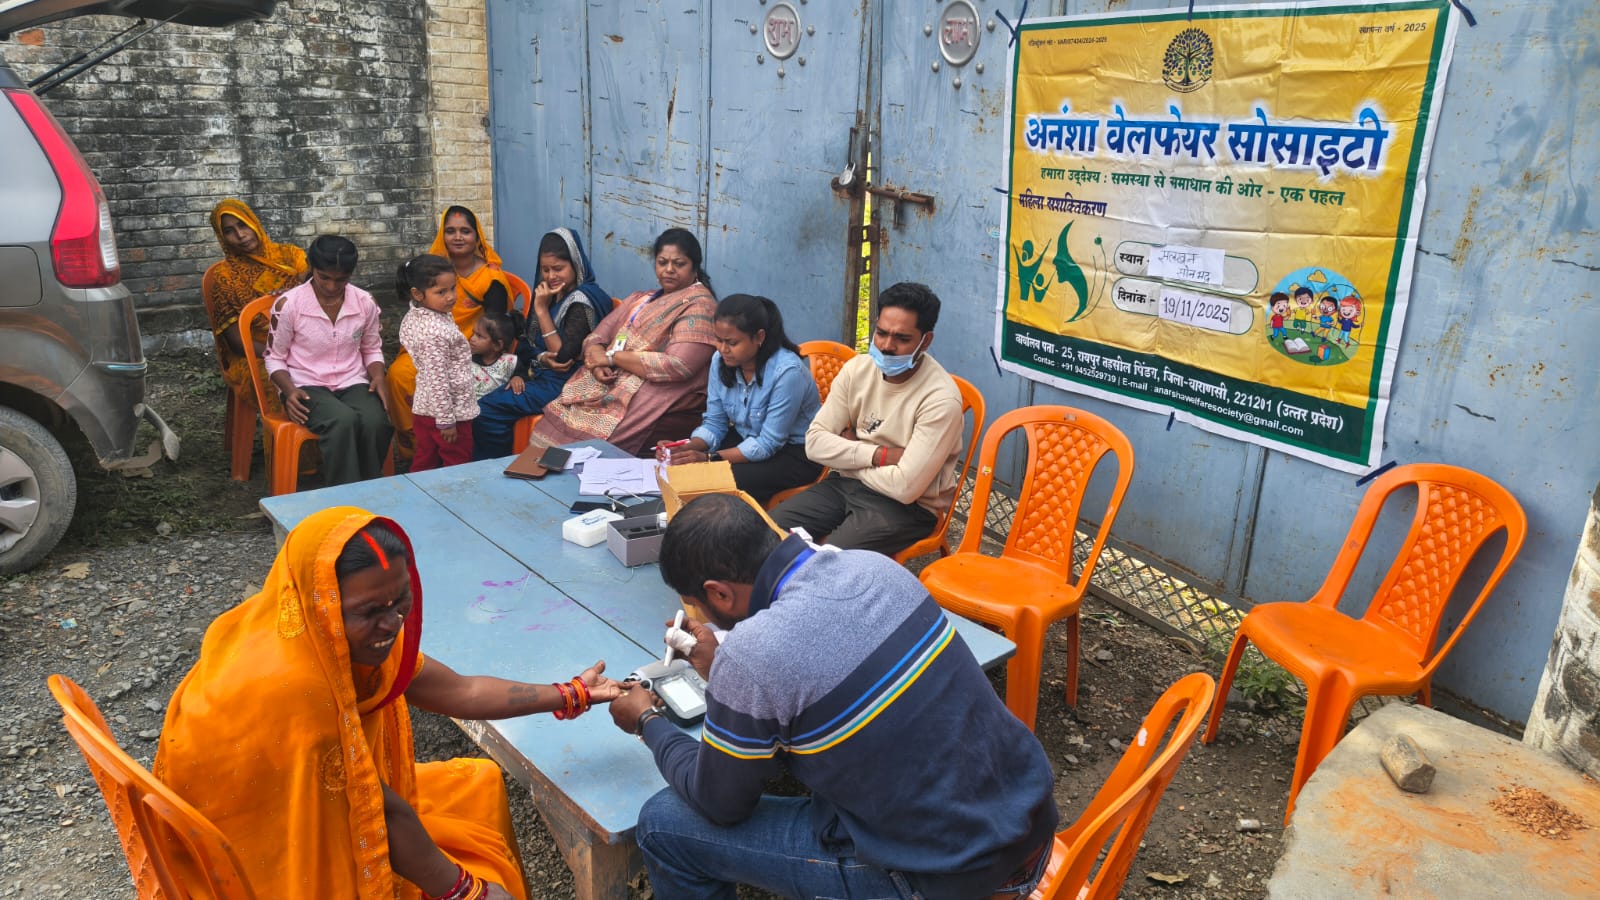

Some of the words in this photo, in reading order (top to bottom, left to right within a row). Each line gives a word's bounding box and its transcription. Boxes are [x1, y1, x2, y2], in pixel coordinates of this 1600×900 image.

[1403, 22, 1427, 33] 2025
[1106, 104, 1220, 159] वेलफेयर
[1228, 107, 1389, 177] सोसाइटी
[1040, 167, 1065, 180] हमारा
[1111, 172, 1150, 187] समस्या
[1153, 171, 1166, 189] से
[1215, 175, 1234, 195] की
[1237, 179, 1263, 198] ओर
[1280, 186, 1305, 203] एक
[1309, 189, 1345, 206] पहल
[1120, 252, 1144, 265] स्थान
[1117, 287, 1147, 303] दिनांक
[1163, 296, 1231, 323] 19/11/2025
[1061, 362, 1073, 372] +91
[1122, 377, 1148, 391] E-mail
[1233, 391, 1272, 412] 221201
